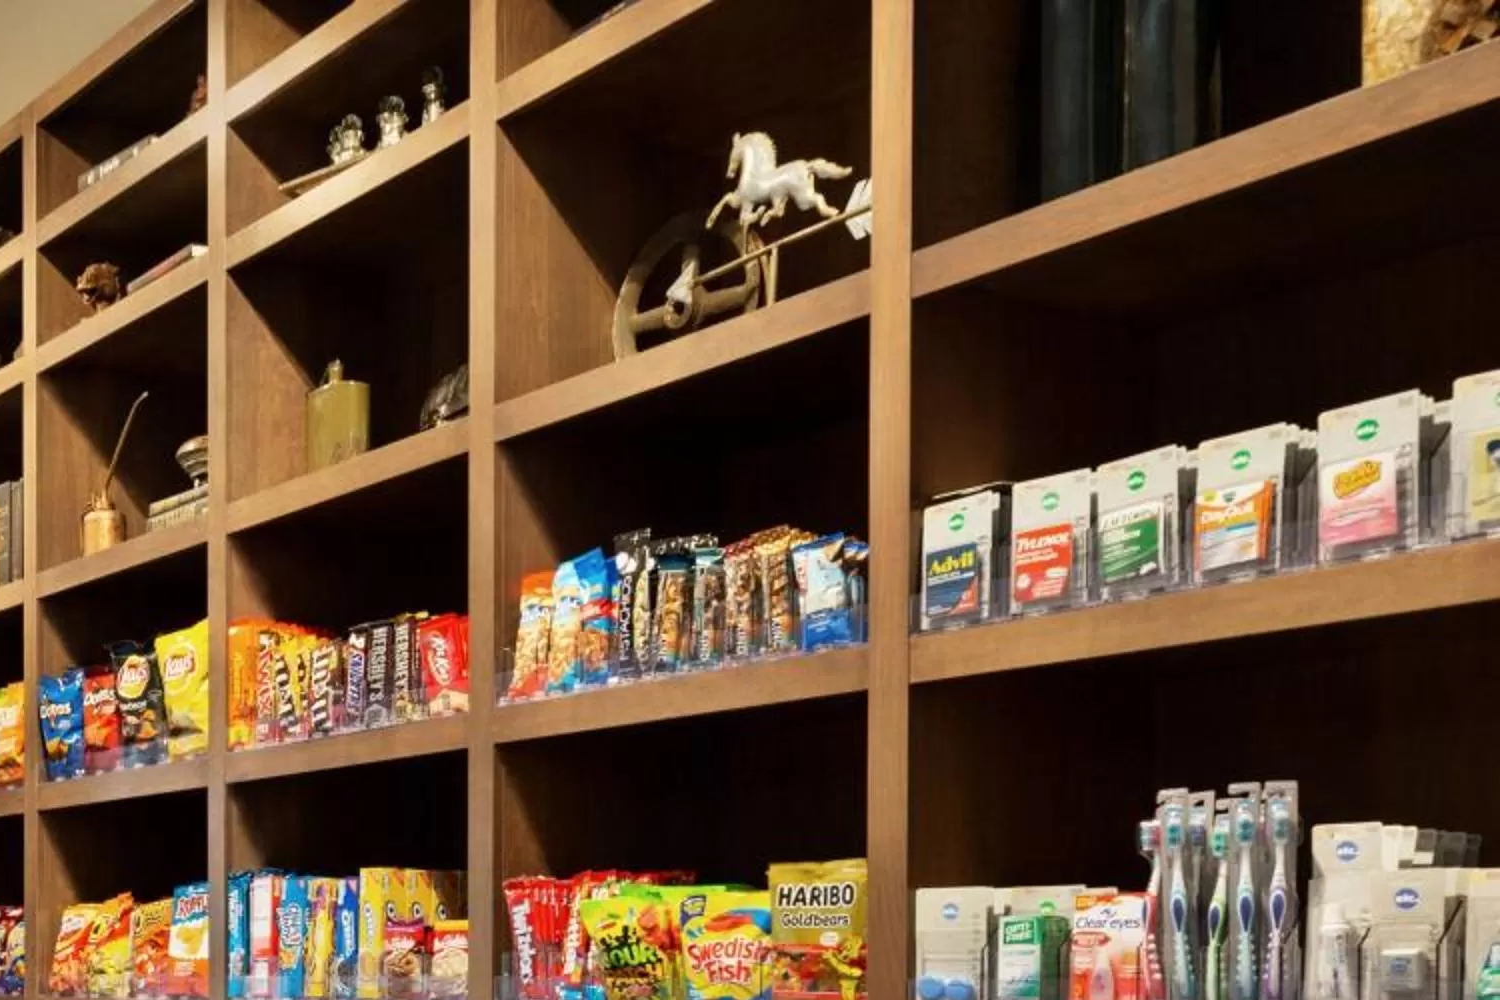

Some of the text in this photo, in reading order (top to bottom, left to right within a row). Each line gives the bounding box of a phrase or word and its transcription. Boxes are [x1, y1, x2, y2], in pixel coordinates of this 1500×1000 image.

[929, 551, 974, 575] Advil
[777, 883, 855, 907] HARIBO
[782, 912, 850, 928] Goldbears
[1075, 917, 1141, 931] Clear eyes
[688, 937, 770, 968] Swedish
[705, 959, 752, 983] Fish
